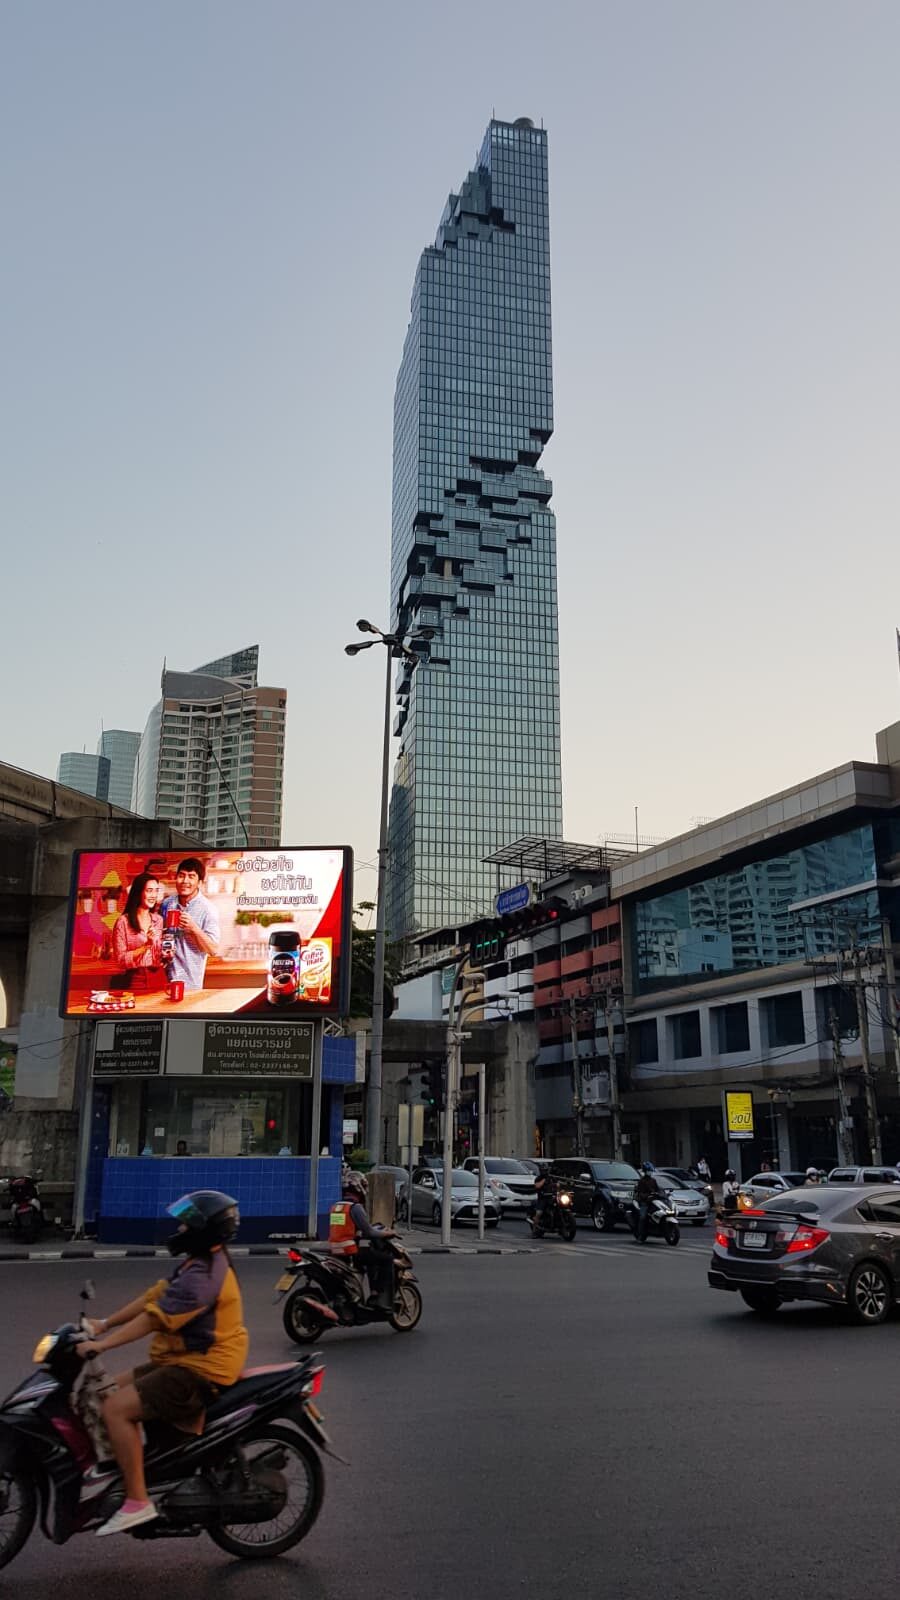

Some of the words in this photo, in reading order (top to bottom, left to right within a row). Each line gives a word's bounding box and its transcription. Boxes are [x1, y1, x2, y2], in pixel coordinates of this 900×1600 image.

[208, 1023, 310, 1038] ตู้ควบคุมการจราจร
